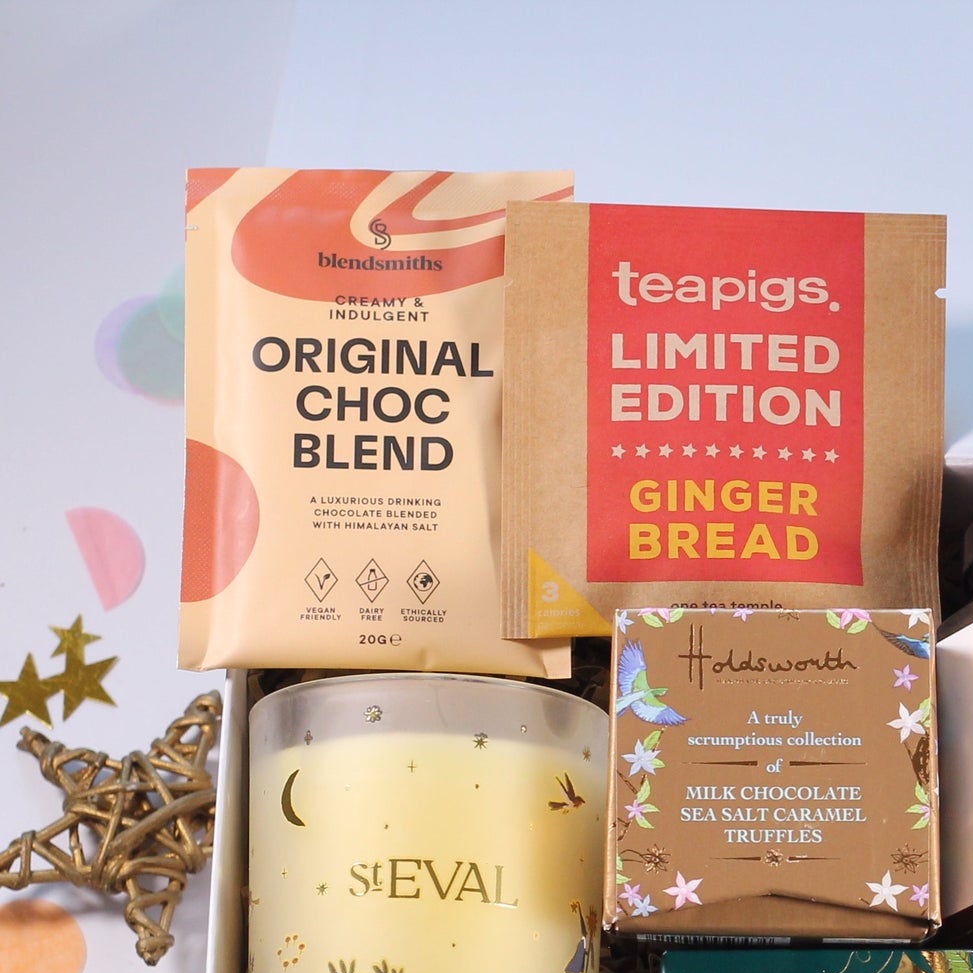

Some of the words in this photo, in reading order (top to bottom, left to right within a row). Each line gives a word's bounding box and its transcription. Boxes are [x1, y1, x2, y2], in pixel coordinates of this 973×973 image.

[318, 252, 443, 272] blendsmiths
[612, 261, 840, 312] teapigs.
[335, 295, 407, 308] CREAMY
[414, 297, 424, 308] &
[329, 309, 429, 322] INDULGENT
[252, 336, 495, 377] ORIGINAL
[611, 333, 840, 373] LIMITED
[296, 384, 450, 424] CHOC
[611, 384, 841, 427] EDITION
[293, 433, 454, 471] BLEND
[310, 496, 317, 504] A
[320, 497, 384, 506] LUXURIOUS
[387, 498, 442, 507] DRINKING
[629, 479, 818, 516] GINGER
[314, 508, 382, 518] CHOCOLATE
[386, 510, 437, 519] BLENDED
[312, 521, 341, 530] WITH
[344, 523, 408, 531] HIMALAYAN
[412, 523, 438, 531] SALT
[629, 523, 819, 560] BREAD
[541, 581, 560, 602] 3
[359, 607, 384, 615] DAIRY
[400, 608, 447, 616] ETHICALLY
[403, 615, 445, 623] SOURCED
[537, 607, 581, 617] calories
[359, 634, 387, 645] 20G
[678, 623, 857, 691] Holdsworth
[747, 711, 761, 725] A
[764, 710, 803, 727] truly
[687, 732, 783, 749] scrumptious
[786, 732, 862, 747] collection
[766, 758, 783, 774] of
[686, 786, 736, 801] MILK
[740, 786, 862, 801] CHOCOLATE
[680, 807, 716, 822] SEA
[722, 808, 769, 822] SALT
[773, 808, 867, 823] CARAMEL
[724, 829, 823, 844] TRUFFLES
